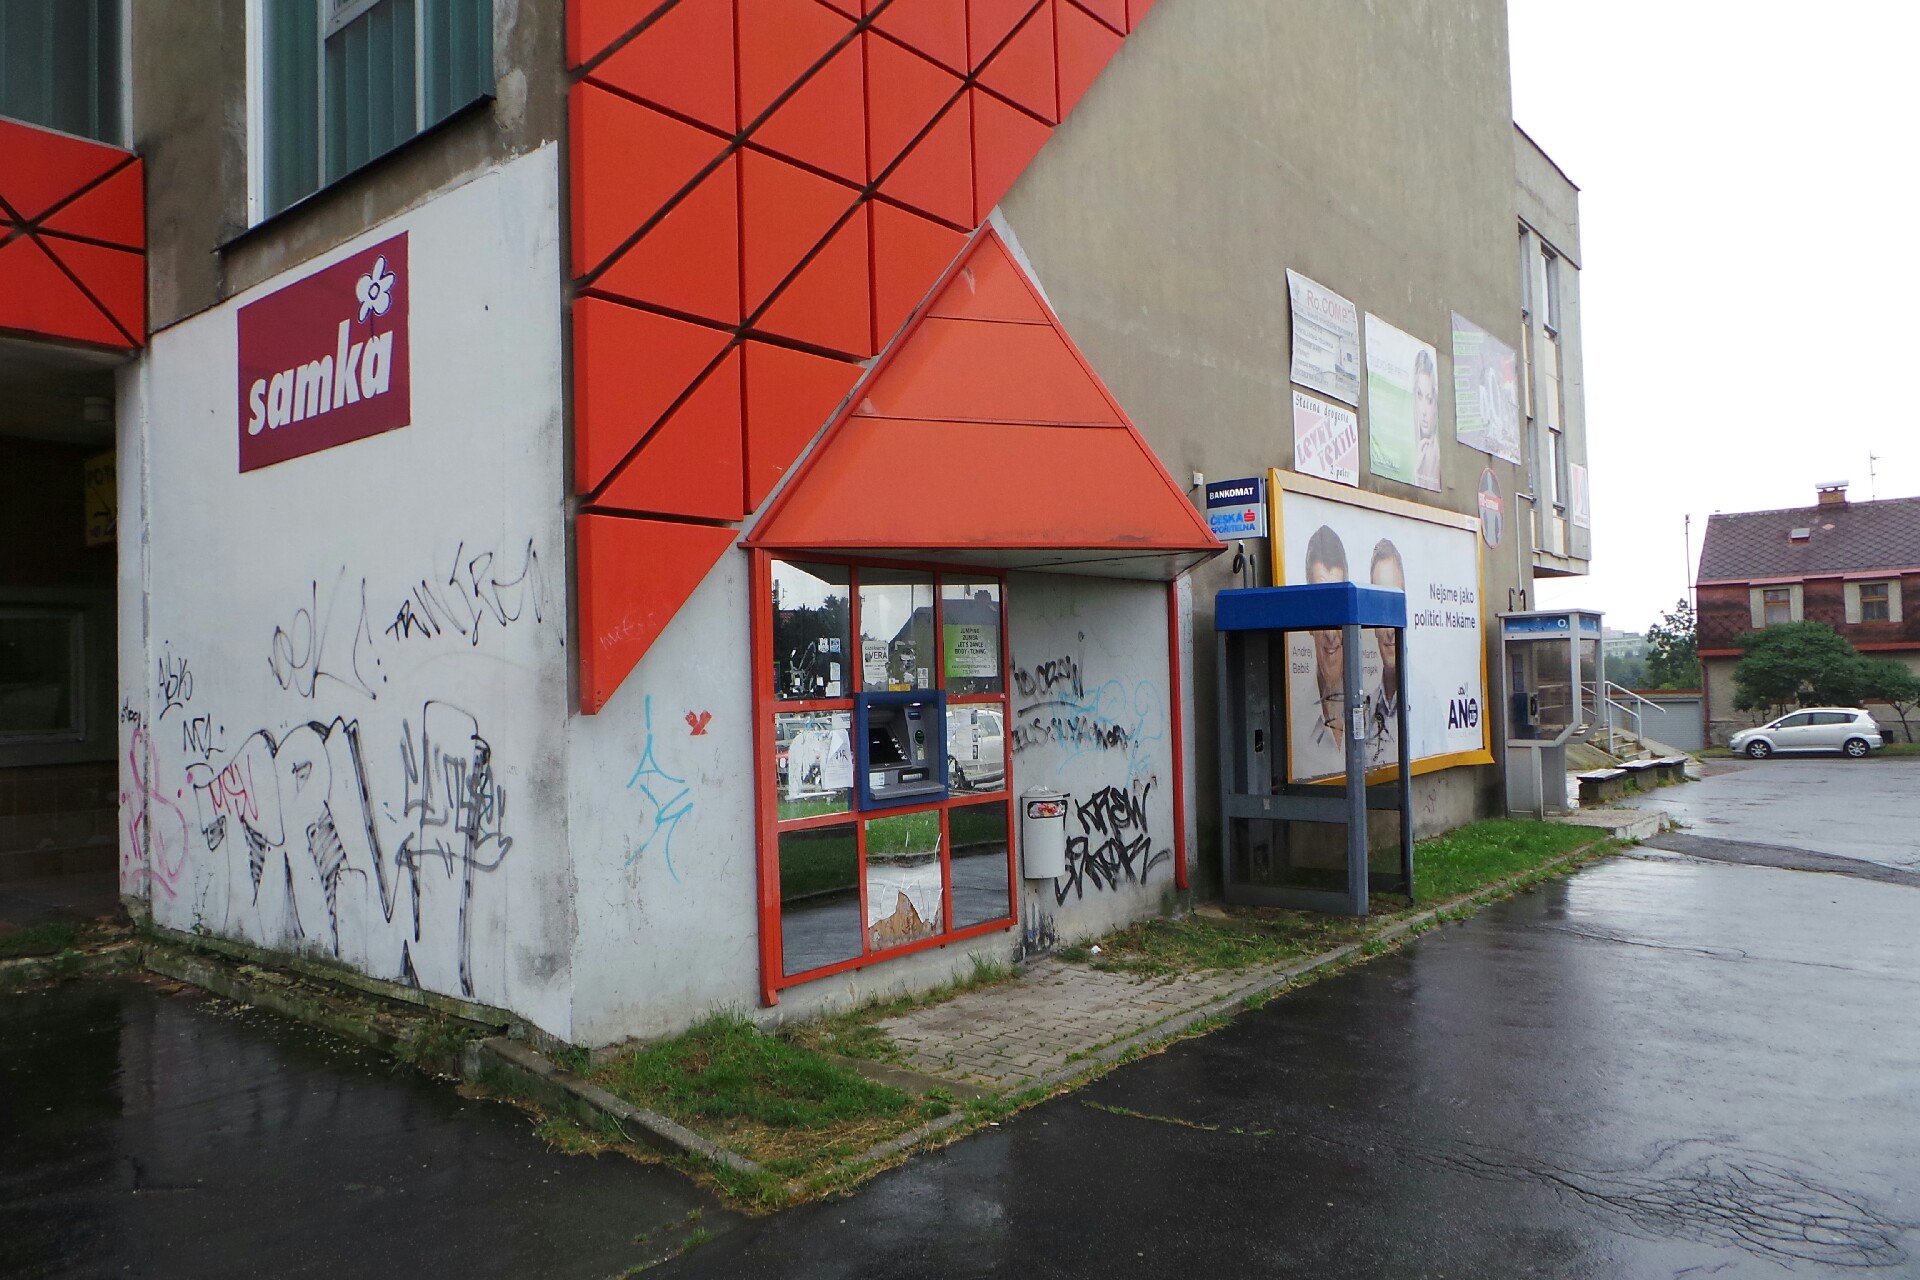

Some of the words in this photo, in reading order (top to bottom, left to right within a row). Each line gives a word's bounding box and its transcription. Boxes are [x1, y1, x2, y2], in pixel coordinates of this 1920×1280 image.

[247, 318, 393, 436] samka
[1209, 487, 1254, 500] BANKOMAT
[1210, 511, 1244, 526] ČESKÁ
[1429, 583, 1458, 604] Nejsme
[1459, 587, 1475, 606] jako
[1414, 609, 1444, 630] politici.
[1445, 611, 1476, 629] Makáme
[1292, 646, 1313, 659] Andrej
[1292, 663, 1310, 674] Babiš
[1447, 698, 1479, 730] ANO
